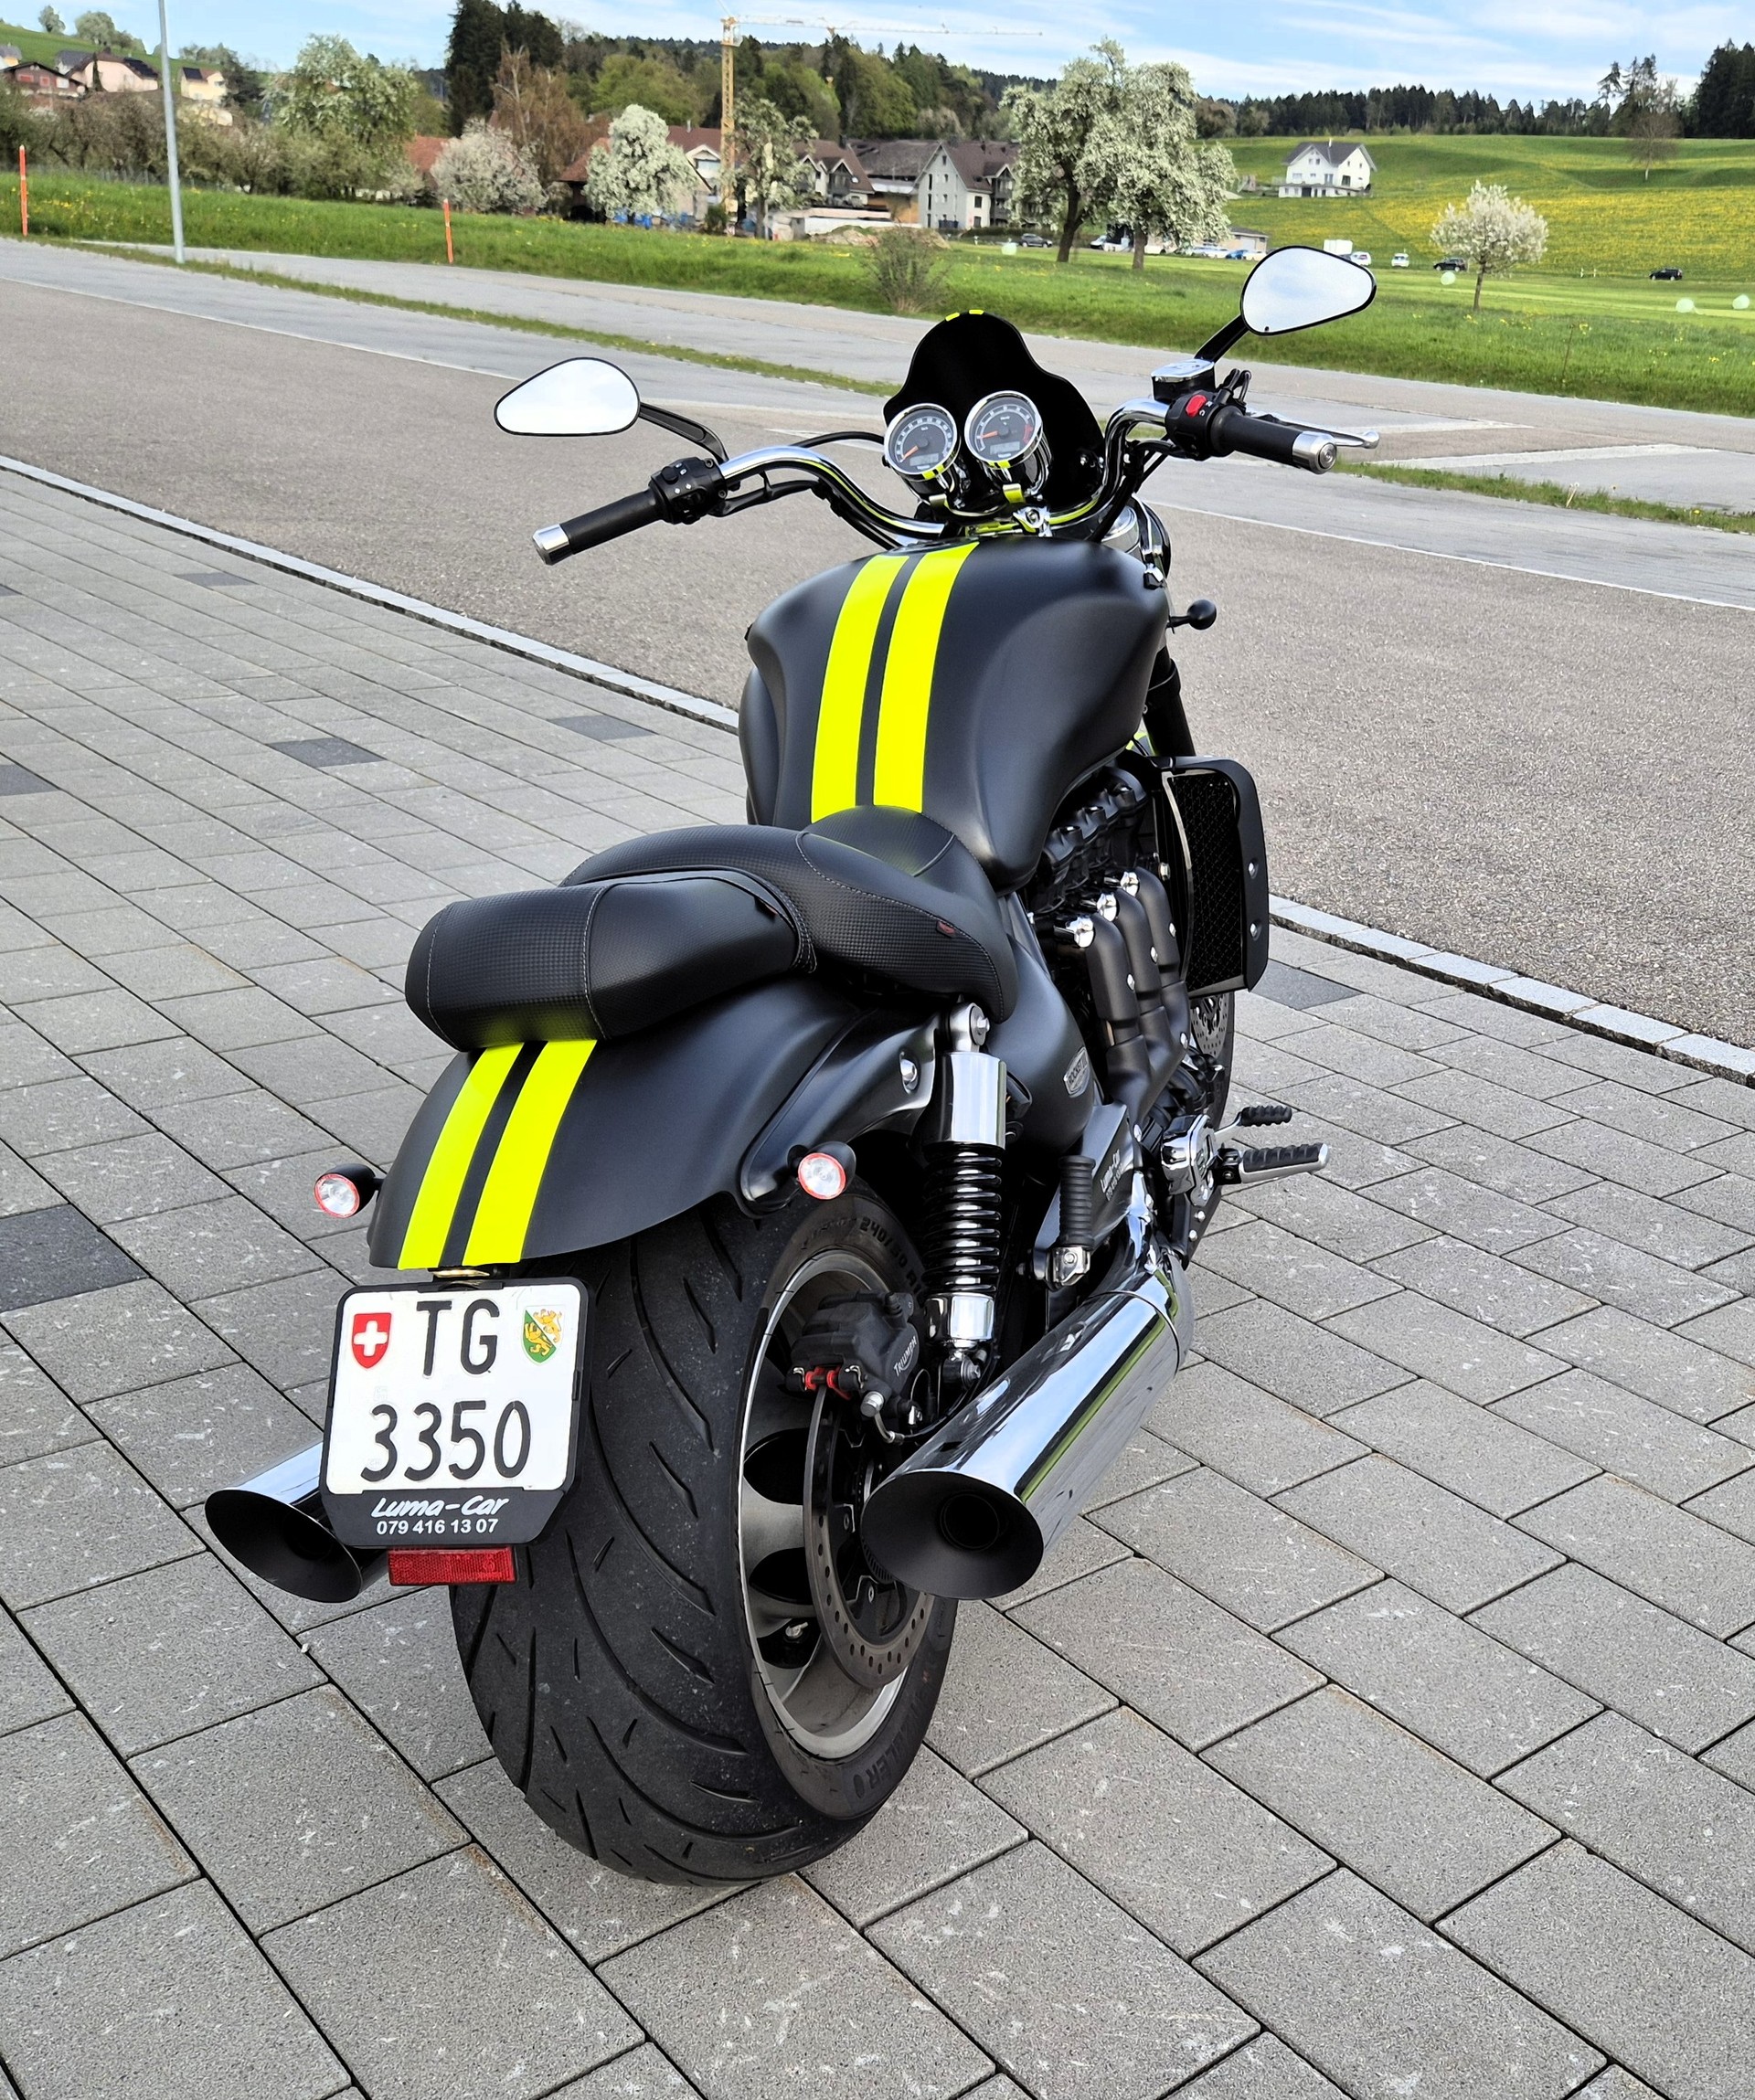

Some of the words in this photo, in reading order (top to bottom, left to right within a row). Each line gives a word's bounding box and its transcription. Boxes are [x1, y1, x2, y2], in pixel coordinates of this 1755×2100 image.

[416, 1299, 500, 1376] TG
[893, 1335, 918, 1376] TRIUMPH
[360, 1400, 532, 1483] 3350
[371, 1495, 509, 1518] Luma-Car
[376, 1520, 409, 1535] 079
[412, 1520, 445, 1534] 416
[451, 1519, 472, 1533] 13
[475, 1518, 498, 1533] 07
